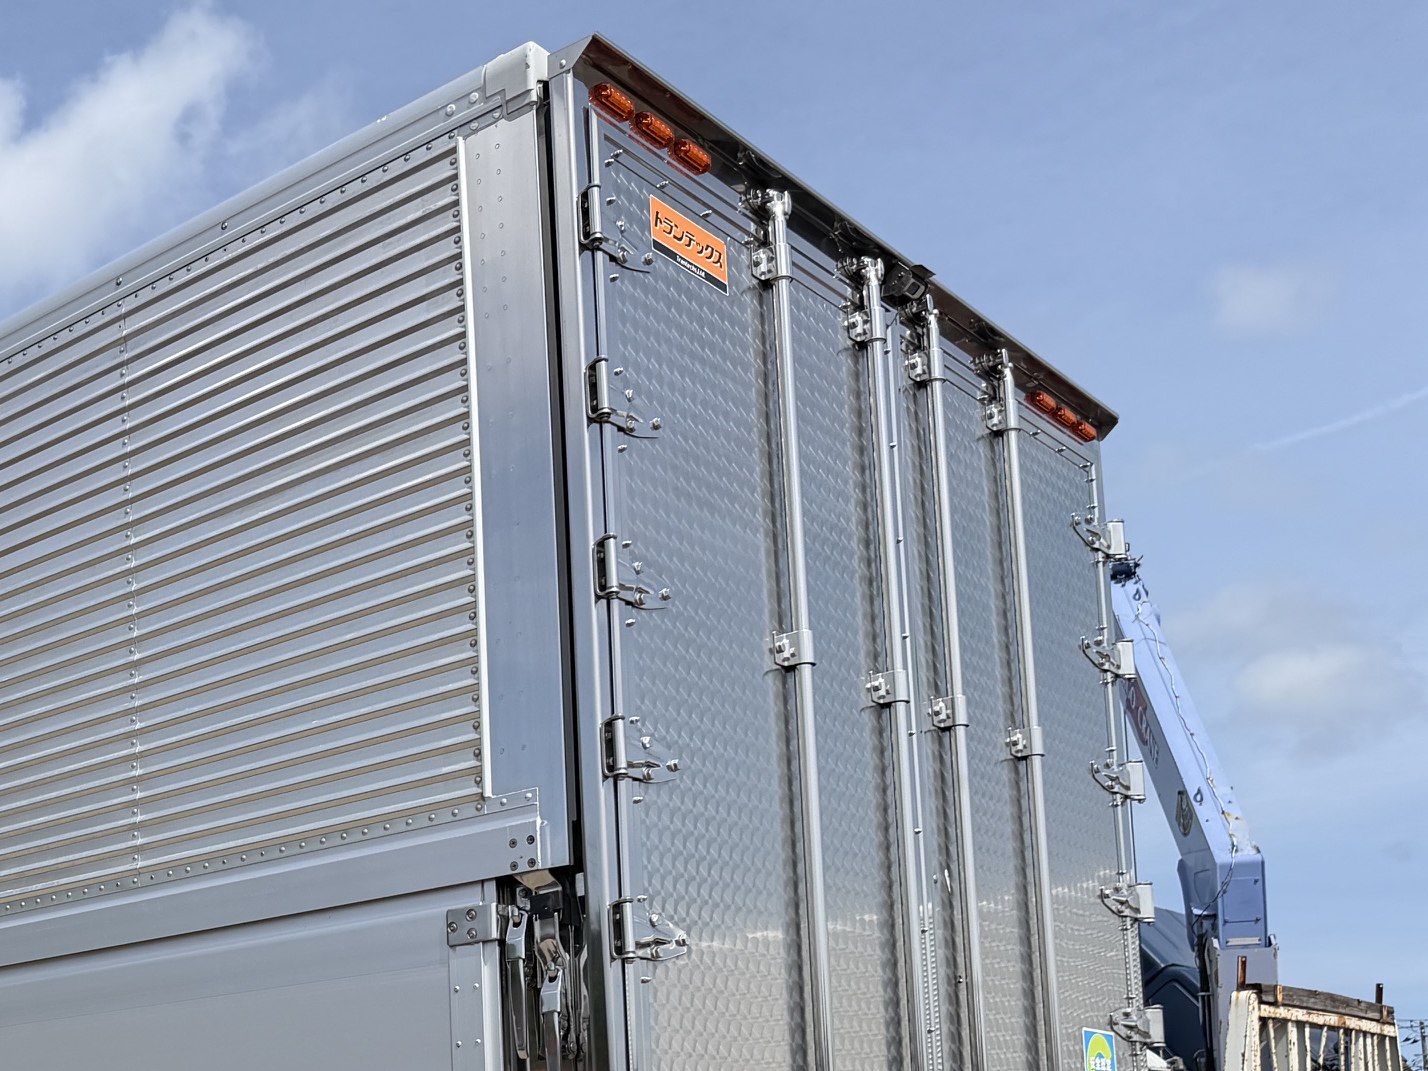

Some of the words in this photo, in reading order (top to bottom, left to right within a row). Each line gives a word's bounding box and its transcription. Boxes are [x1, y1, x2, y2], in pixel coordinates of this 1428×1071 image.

[654, 210, 724, 270] トランテックス
